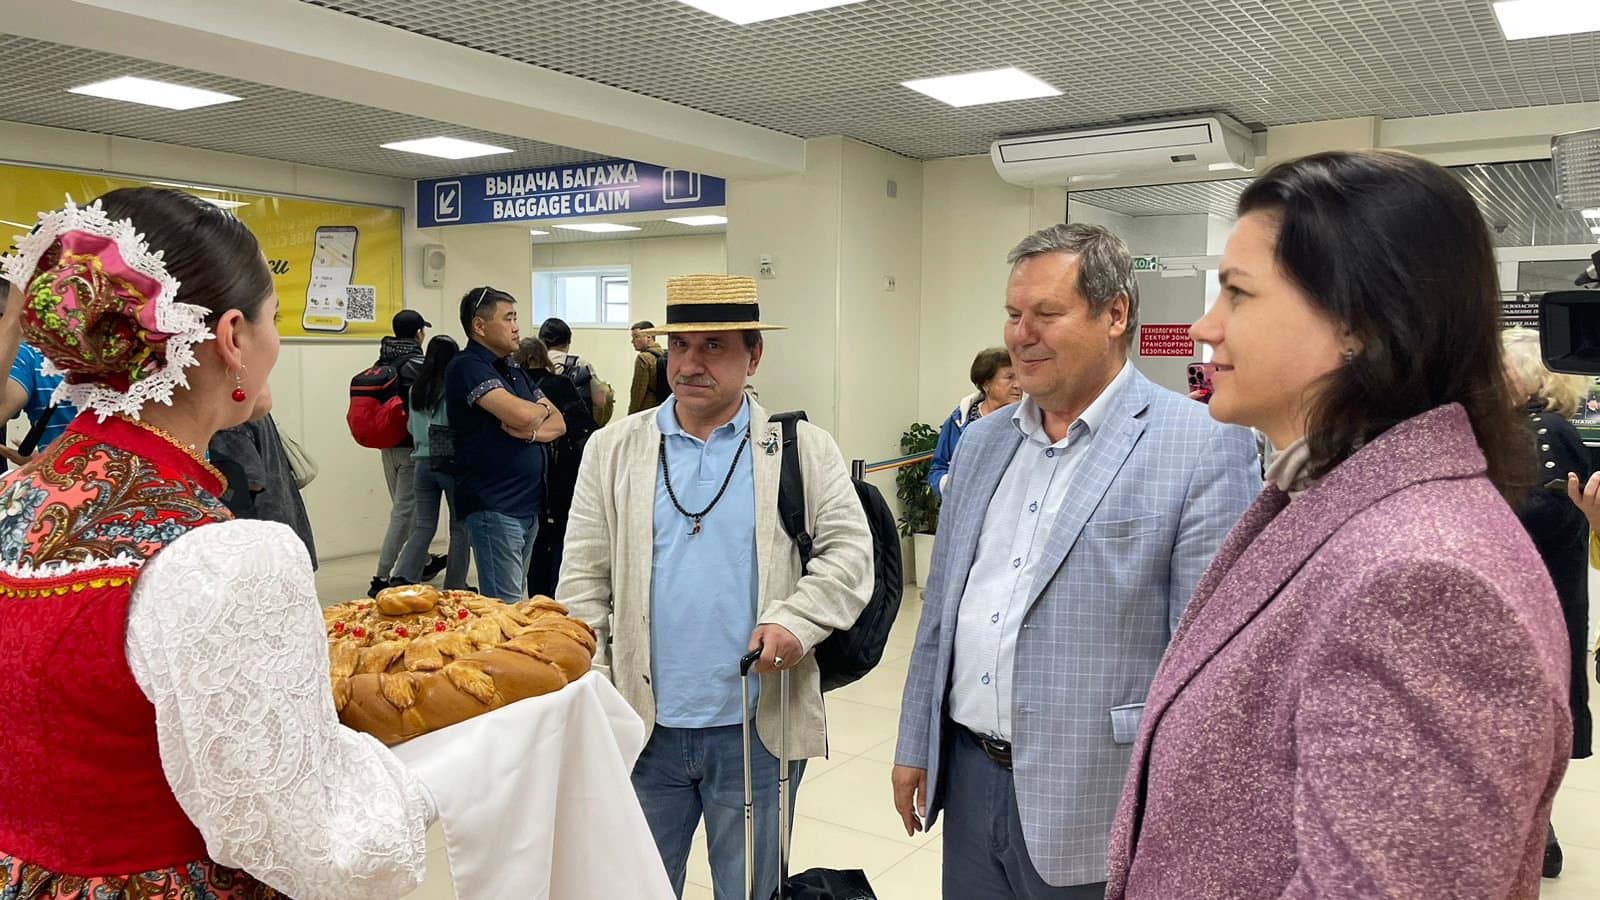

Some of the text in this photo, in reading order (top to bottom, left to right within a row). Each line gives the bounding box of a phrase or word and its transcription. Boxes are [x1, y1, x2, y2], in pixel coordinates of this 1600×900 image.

[486, 163, 637, 196] ВЫДАЧА БАГАЖА
[493, 190, 629, 219] BAGGAGE CLAIM
